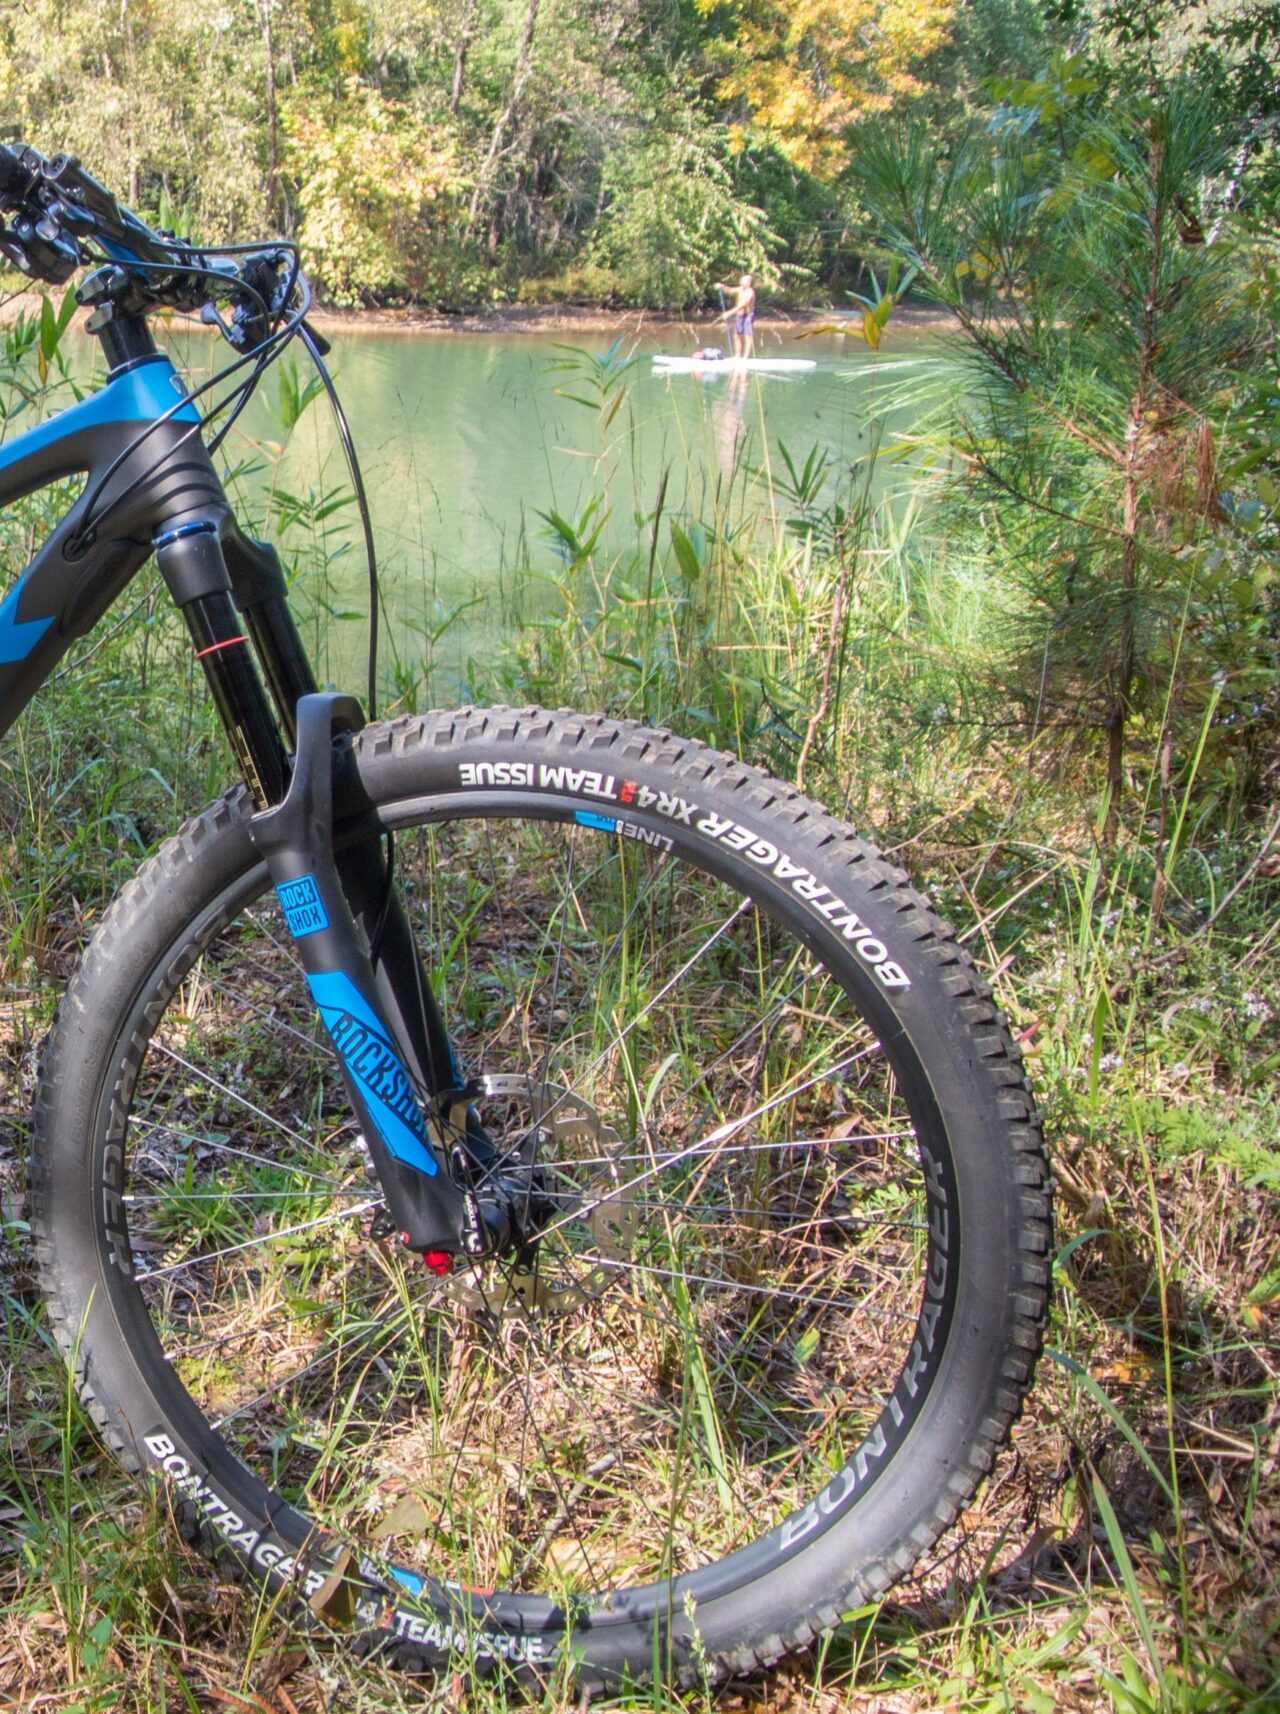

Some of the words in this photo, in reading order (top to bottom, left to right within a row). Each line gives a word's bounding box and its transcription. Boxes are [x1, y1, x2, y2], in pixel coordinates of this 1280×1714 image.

[458, 762, 534, 787] ISSUE
[539, 764, 617, 800] TEAM
[638, 785, 699, 826] XR4
[624, 823, 674, 852] LINE
[280, 881, 314, 908] ROCK
[697, 812, 911, 986] BONTRAGER
[289, 905, 322, 931] SHOX
[779, 1146, 949, 1550] BONTRAGER
[144, 1433, 325, 1596] BONTRAGER
[395, 1611, 470, 1652] TEAM
